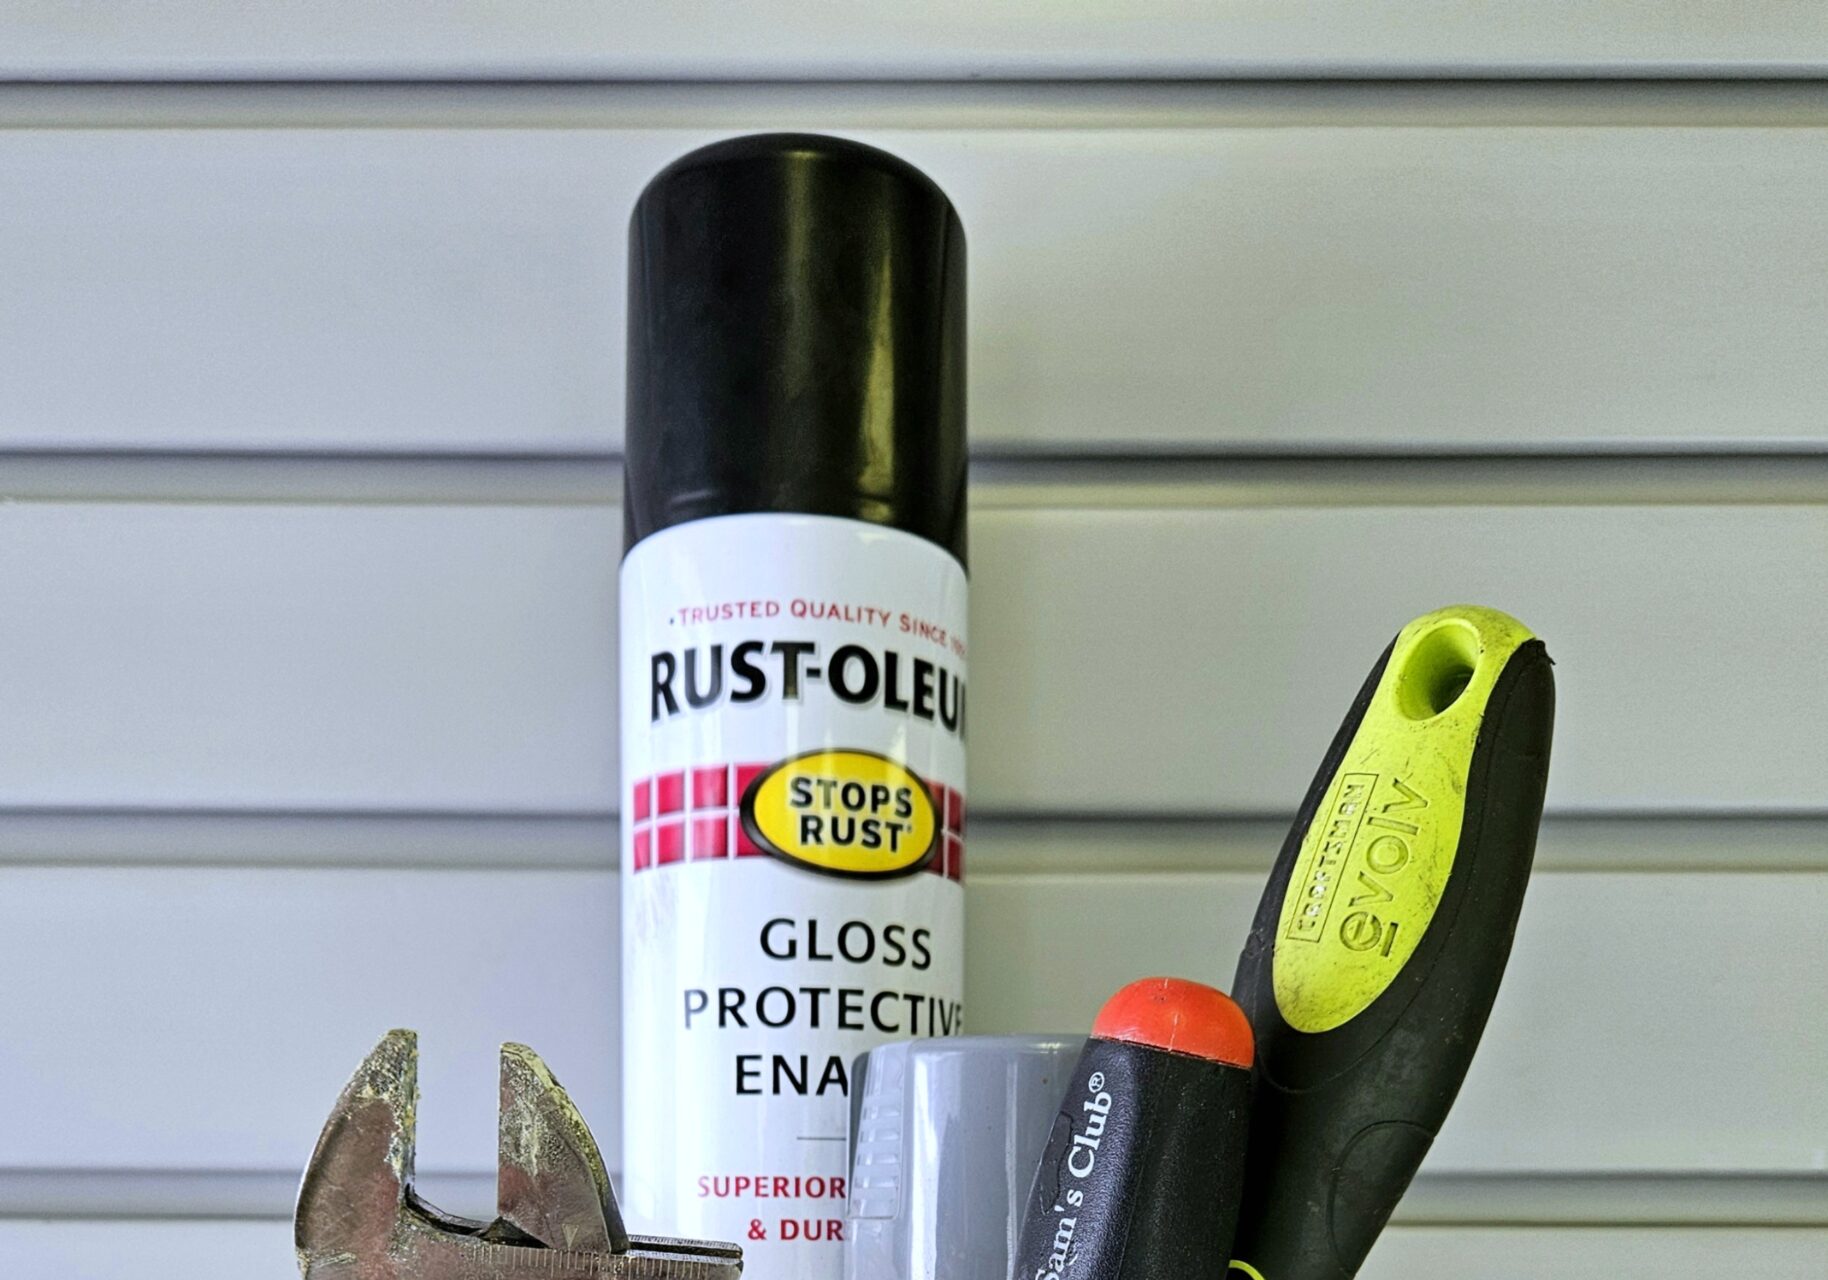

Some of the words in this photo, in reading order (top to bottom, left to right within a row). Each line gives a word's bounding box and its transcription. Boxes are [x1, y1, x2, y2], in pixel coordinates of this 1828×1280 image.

[678, 600, 781, 627] TRUSTED
[790, 599, 892, 627] QUALITY
[899, 612, 947, 648] SINCE
[651, 640, 966, 741] RUST-OLEU
[789, 776, 913, 819] STOPS
[760, 918, 932, 971] GLOSS
[736, 1055, 849, 1097] ENA
[697, 1175, 847, 1199] SUPERIOR
[747, 1218, 767, 1241] &
